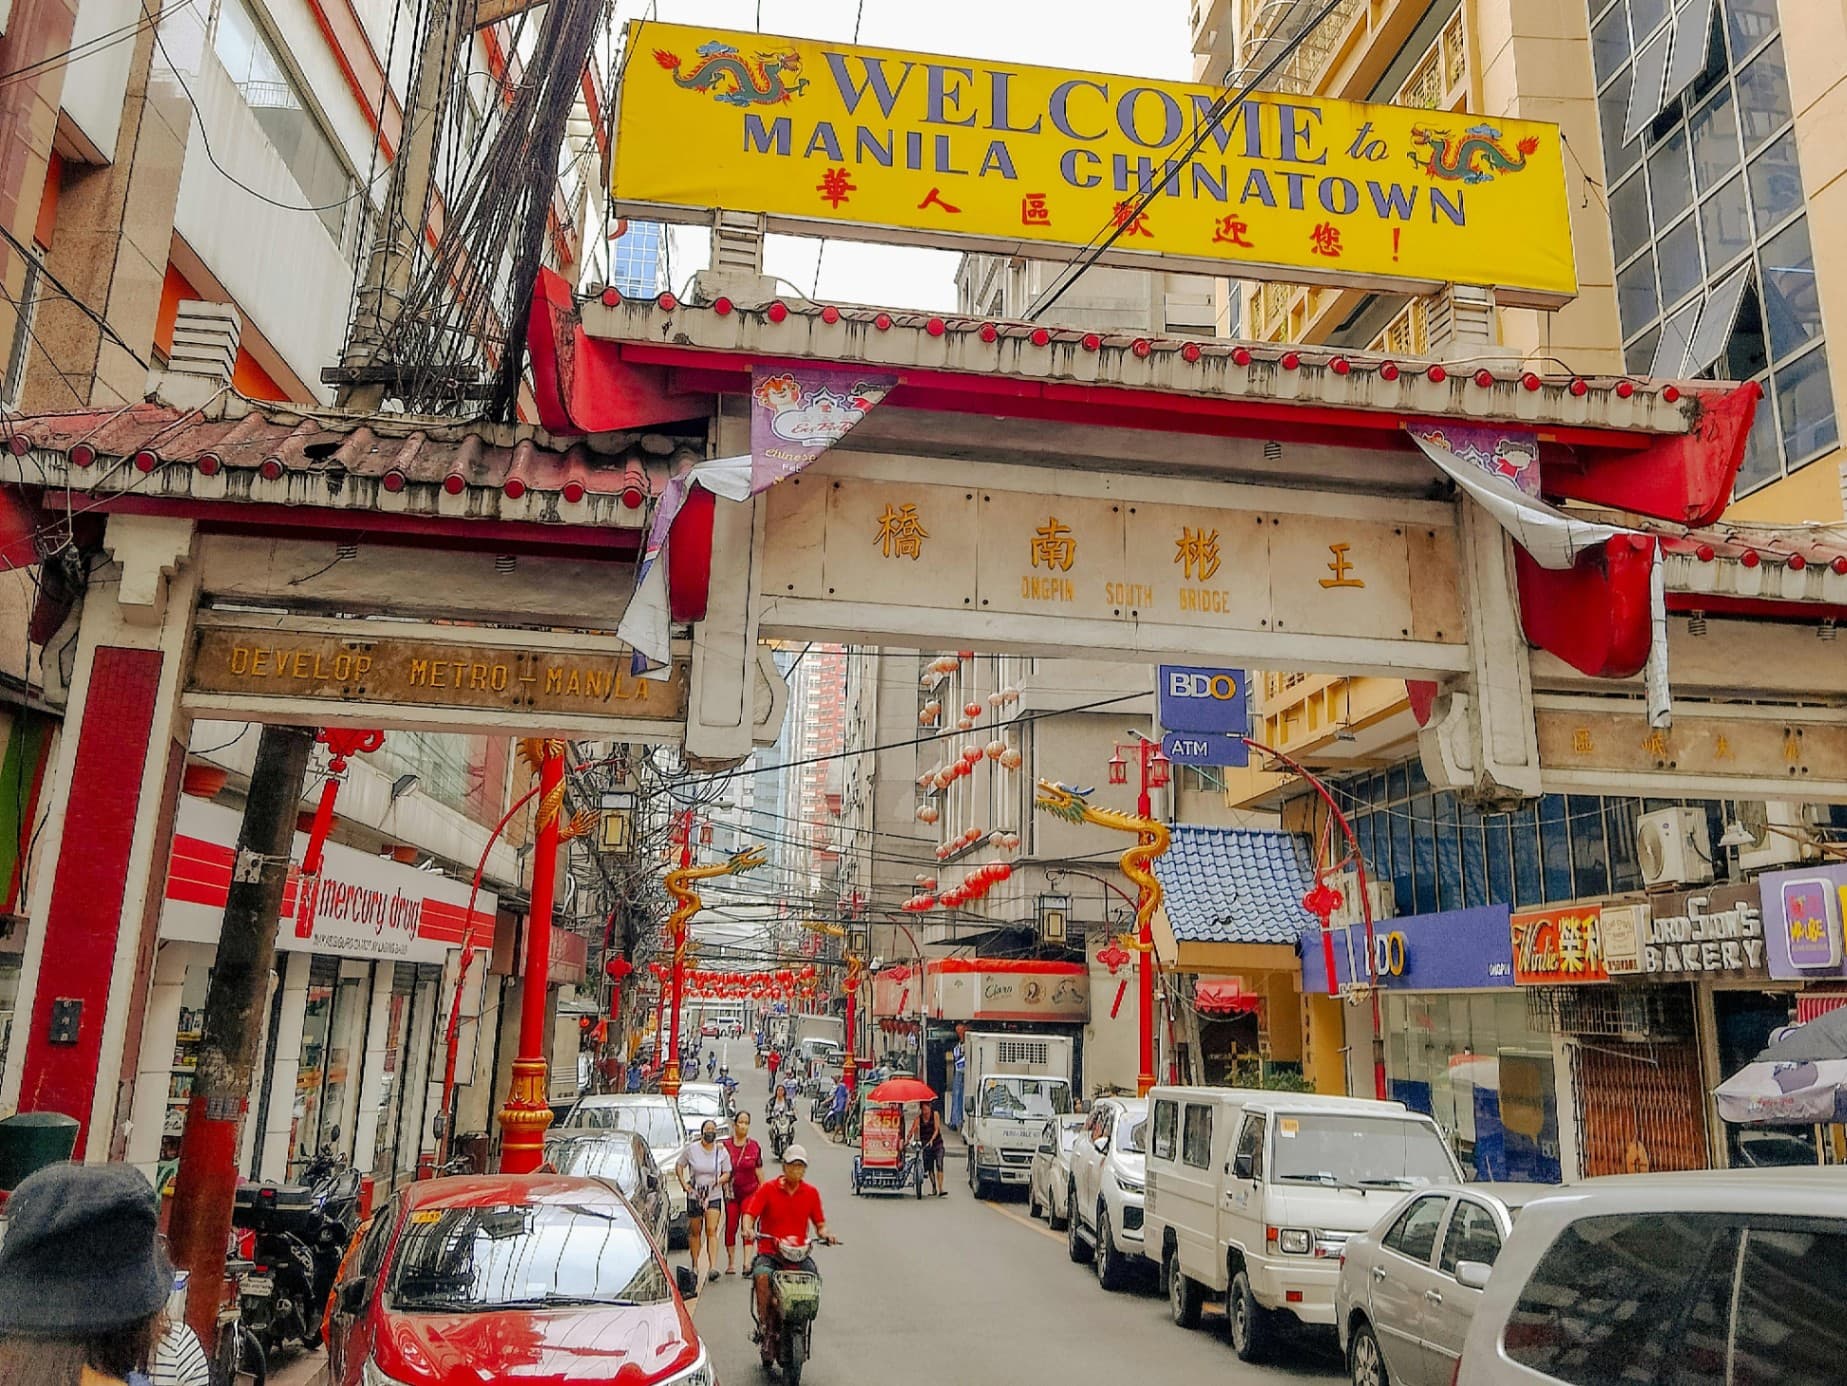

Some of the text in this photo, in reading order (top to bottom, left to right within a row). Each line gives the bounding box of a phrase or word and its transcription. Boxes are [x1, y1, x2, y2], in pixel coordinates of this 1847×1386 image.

[821, 52, 1388, 165] WELCOME to
[744, 113, 1465, 227] MANILA CHINATOWN
[1021, 575, 1231, 613] ONGPIN SOUTH BRIDGE
[230, 647, 372, 682] DEVELOP
[1169, 672, 1237, 700] BDO
[1172, 740, 1208, 757] ATM
[318, 878, 421, 941] mercury drug
[1643, 904, 1691, 944] LORD
[1645, 938, 1763, 973] BAKERY
